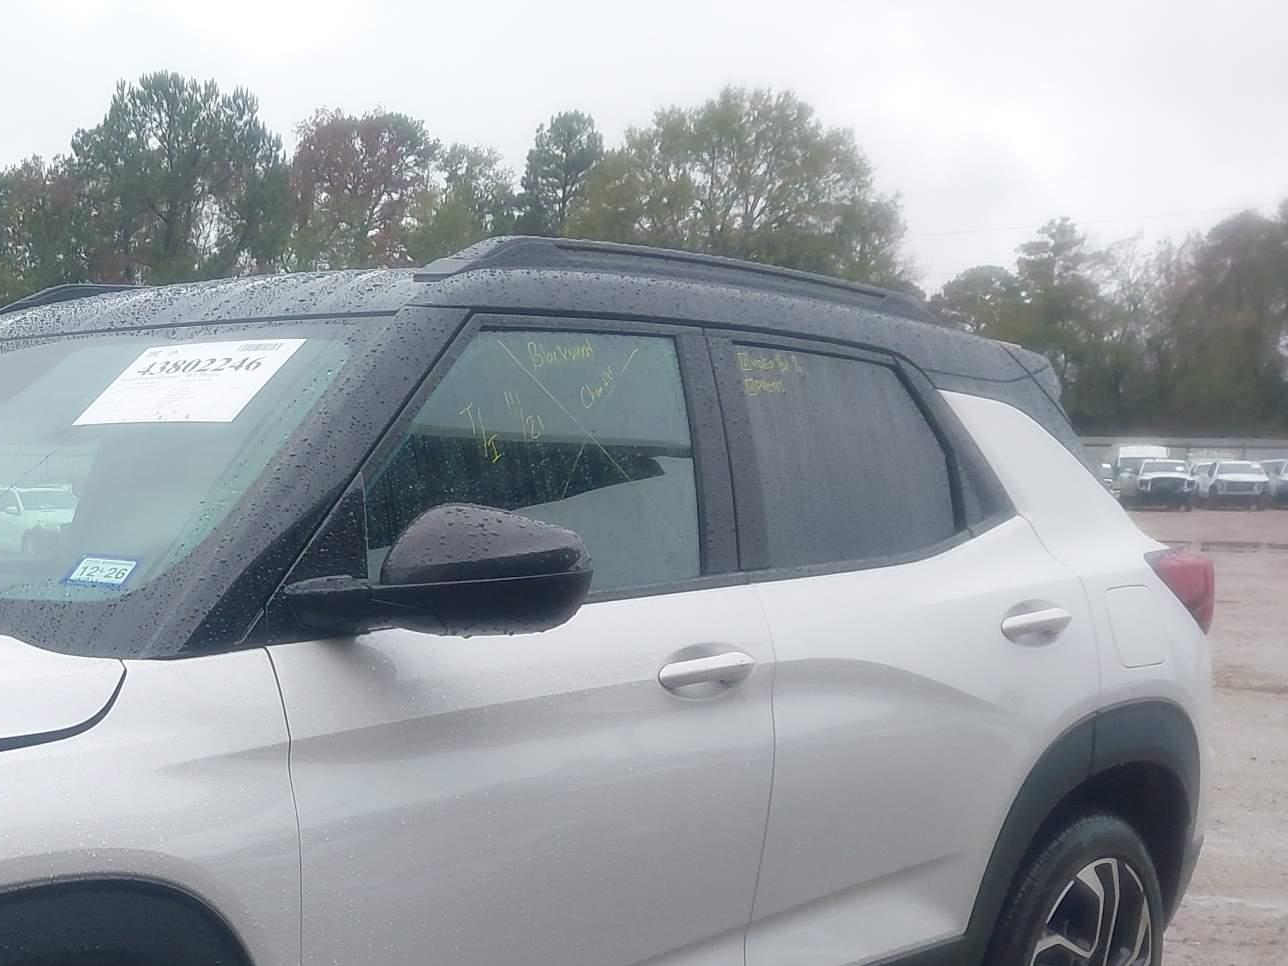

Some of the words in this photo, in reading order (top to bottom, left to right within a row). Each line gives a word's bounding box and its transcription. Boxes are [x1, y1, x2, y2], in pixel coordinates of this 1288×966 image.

[137, 355, 267, 377] 43802246
[79, 565, 100, 577] 12
[104, 567, 128, 579] 26
